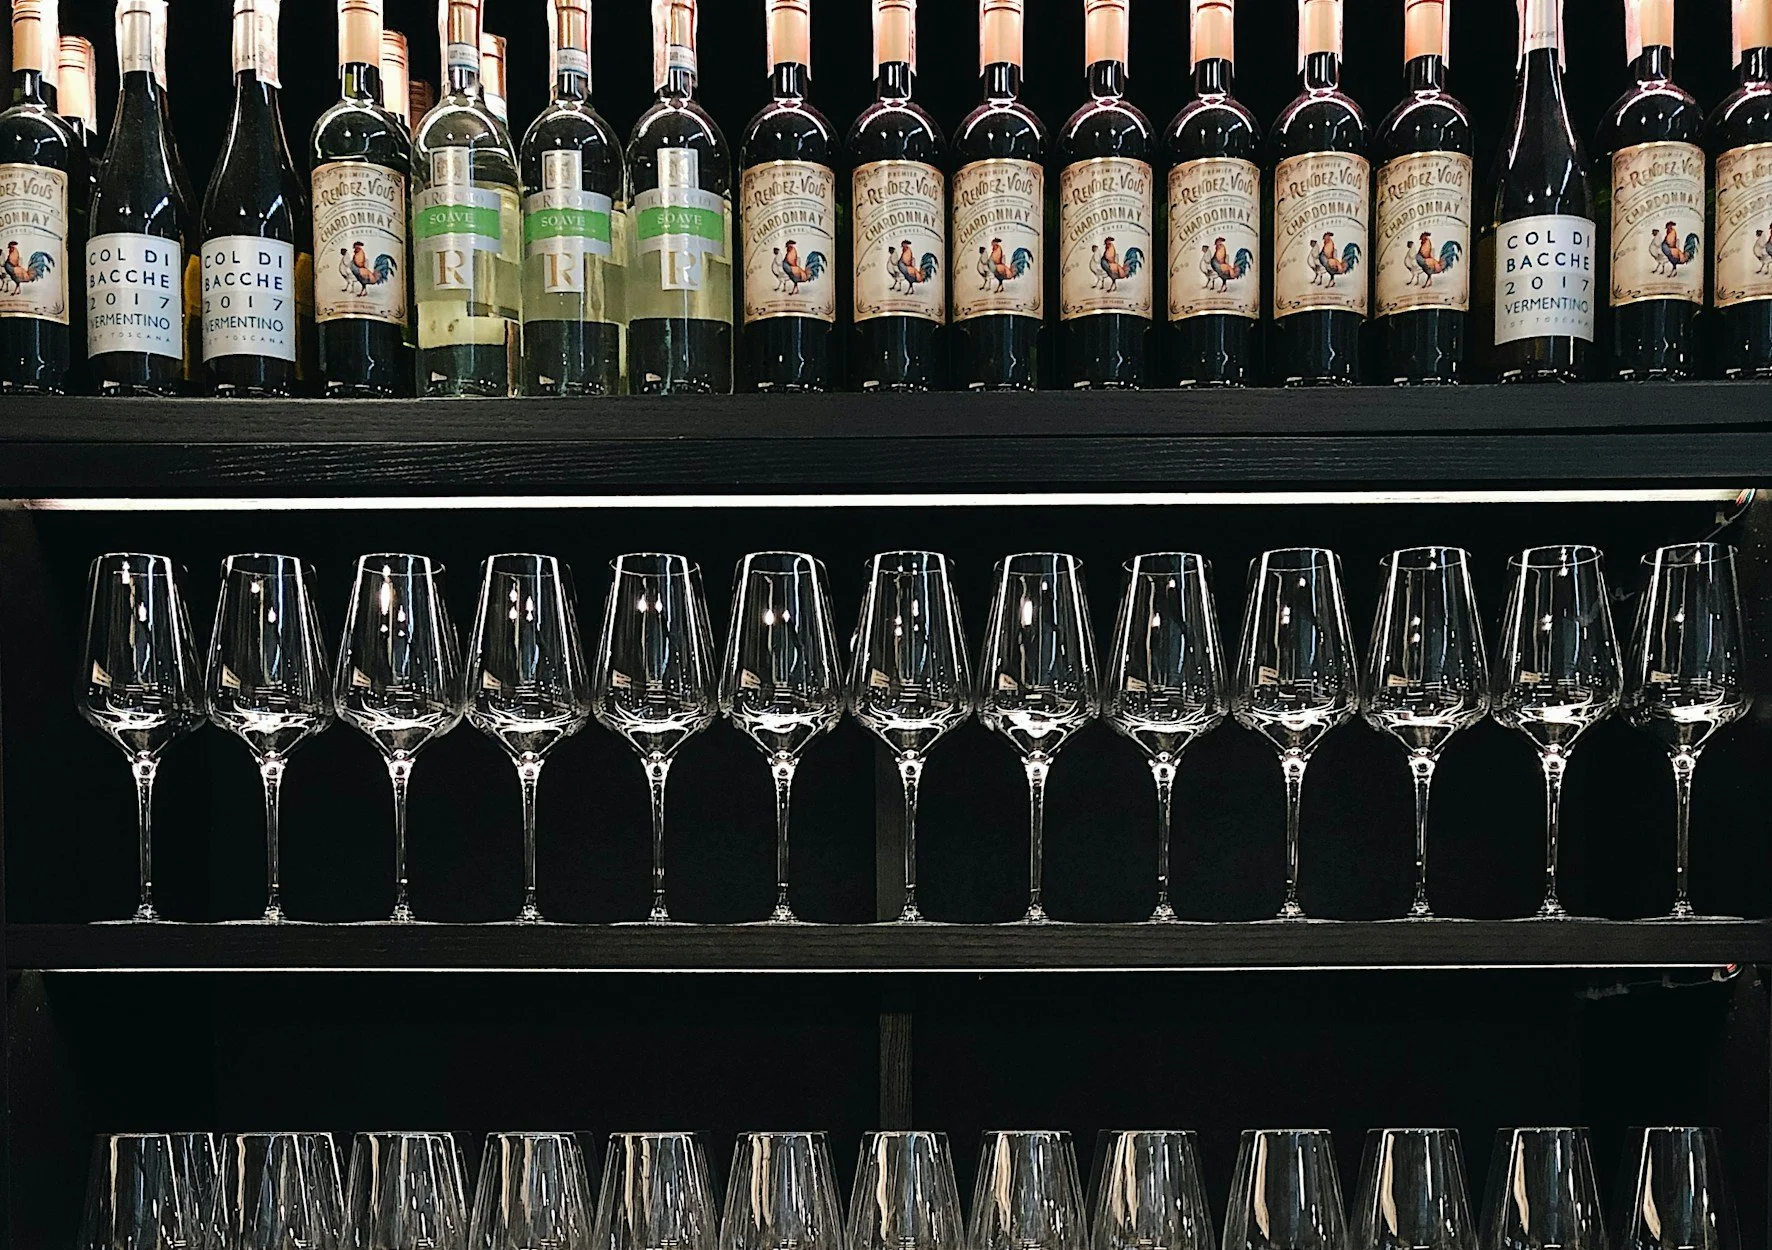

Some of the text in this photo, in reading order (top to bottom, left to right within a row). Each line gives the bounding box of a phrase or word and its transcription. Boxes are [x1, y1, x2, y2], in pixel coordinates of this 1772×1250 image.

[320, 211, 394, 242] CHARDONNAY
[429, 212, 474, 225] SOAVE
[541, 216, 585, 227] SOAVE
[657, 213, 702, 225] SOAVE
[753, 210, 825, 244] CHARDONNAY
[865, 211, 936, 243] CHARDONNAY
[960, 208, 1030, 244] CHARDONNAY
[1070, 206, 1142, 242] CHARDONNAY
[1179, 206, 1251, 242] CHARDONNAY
[1286, 201, 1361, 238] CHARDONNAY
[1385, 200, 1460, 239] CHARDONNAY
[1507, 230, 1590, 249] COL DI
[89, 248, 169, 266] COL DI
[204, 250, 283, 269] COL DI
[1507, 252, 1589, 273] BACCHE
[436, 251, 465, 286] R
[546, 253, 577, 288] R
[89, 269, 170, 289] BACCHE
[204, 273, 283, 292] BACCHE
[1506, 276, 1589, 295] 2017
[90, 293, 170, 310] 2017
[205, 296, 283, 315] 2017
[1505, 296, 1588, 315] VERMENTINO
[90, 313, 171, 331] VERMENTINO
[205, 317, 284, 333] VERMENTINO
